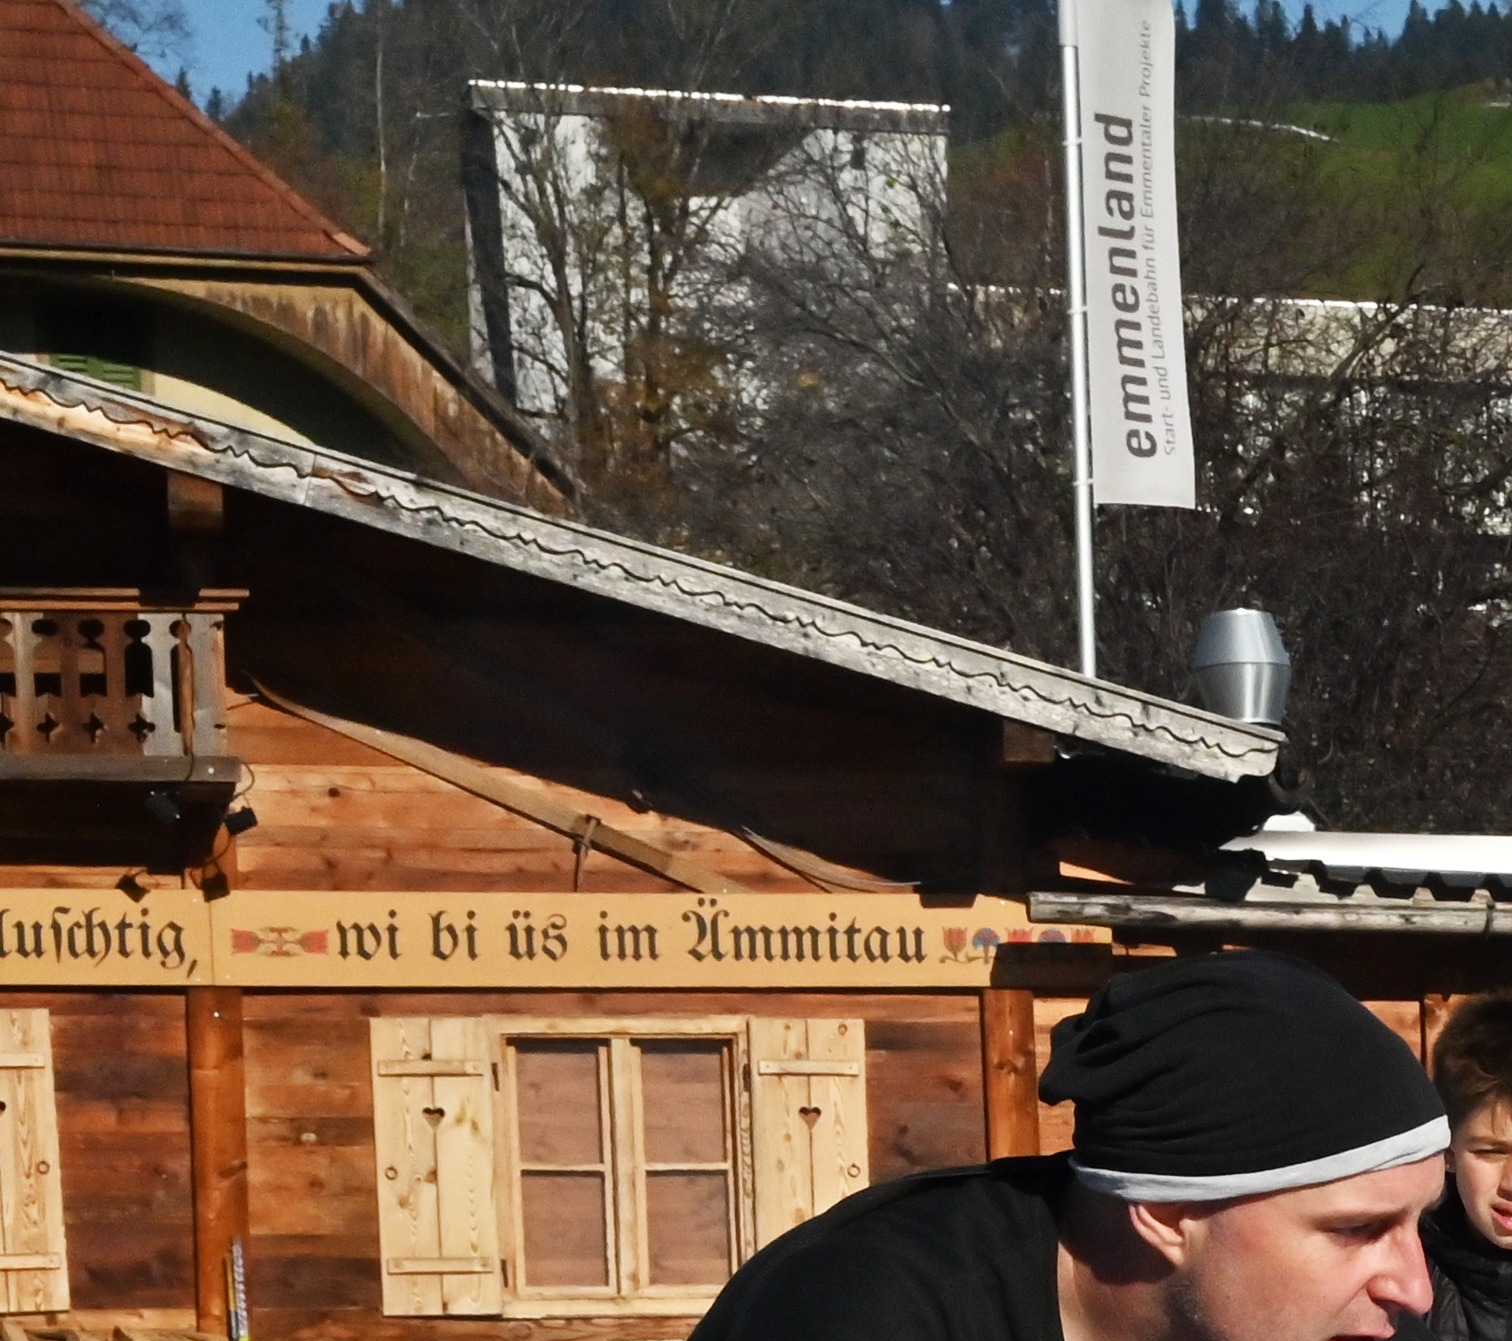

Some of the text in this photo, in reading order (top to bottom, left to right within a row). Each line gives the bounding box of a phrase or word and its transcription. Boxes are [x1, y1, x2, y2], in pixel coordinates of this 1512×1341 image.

[1138, 19, 1154, 98] Projekte
[1138, 103, 1155, 219] Emmentaler
[1094, 111, 1158, 458] emmenland
[1143, 257, 1167, 360] Landebahn
[1151, 366, 1172, 401] und
[336, 909, 402, 962] wi
[430, 909, 479, 962] bi
[505, 909, 569, 962] üs
[598, 909, 660, 963] im
